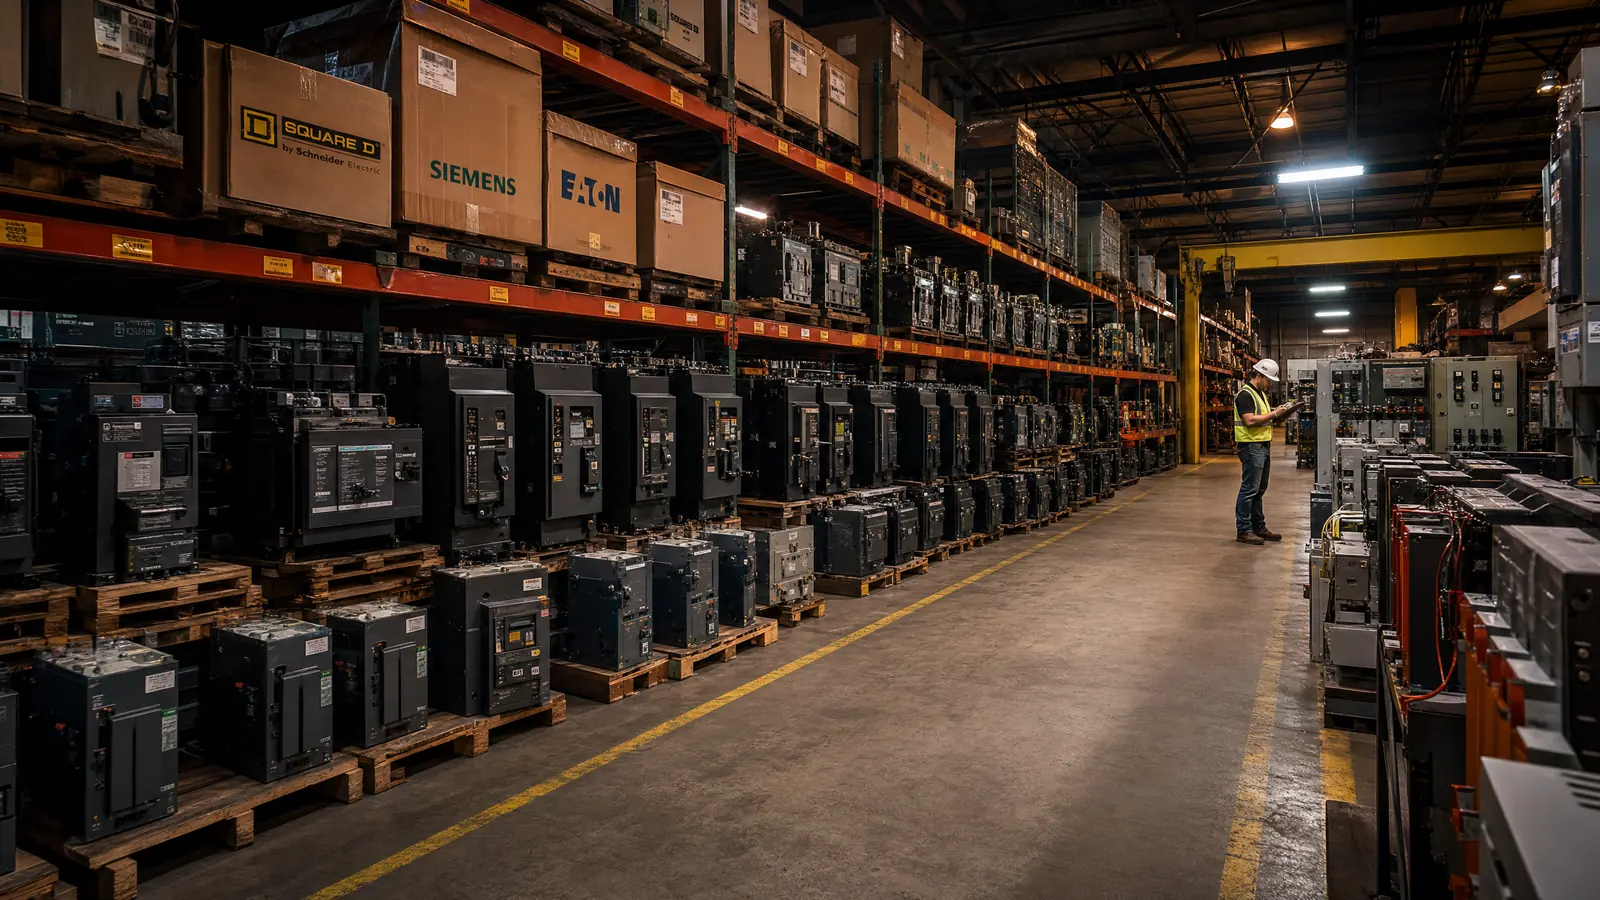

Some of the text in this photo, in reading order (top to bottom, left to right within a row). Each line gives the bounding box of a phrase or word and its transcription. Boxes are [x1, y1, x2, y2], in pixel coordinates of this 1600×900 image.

[284, 121, 376, 155] SQUARE D
[282, 143, 381, 175] by Schneider Electric
[430, 160, 516, 196] SIEMENS
[561, 169, 621, 214] EATON
